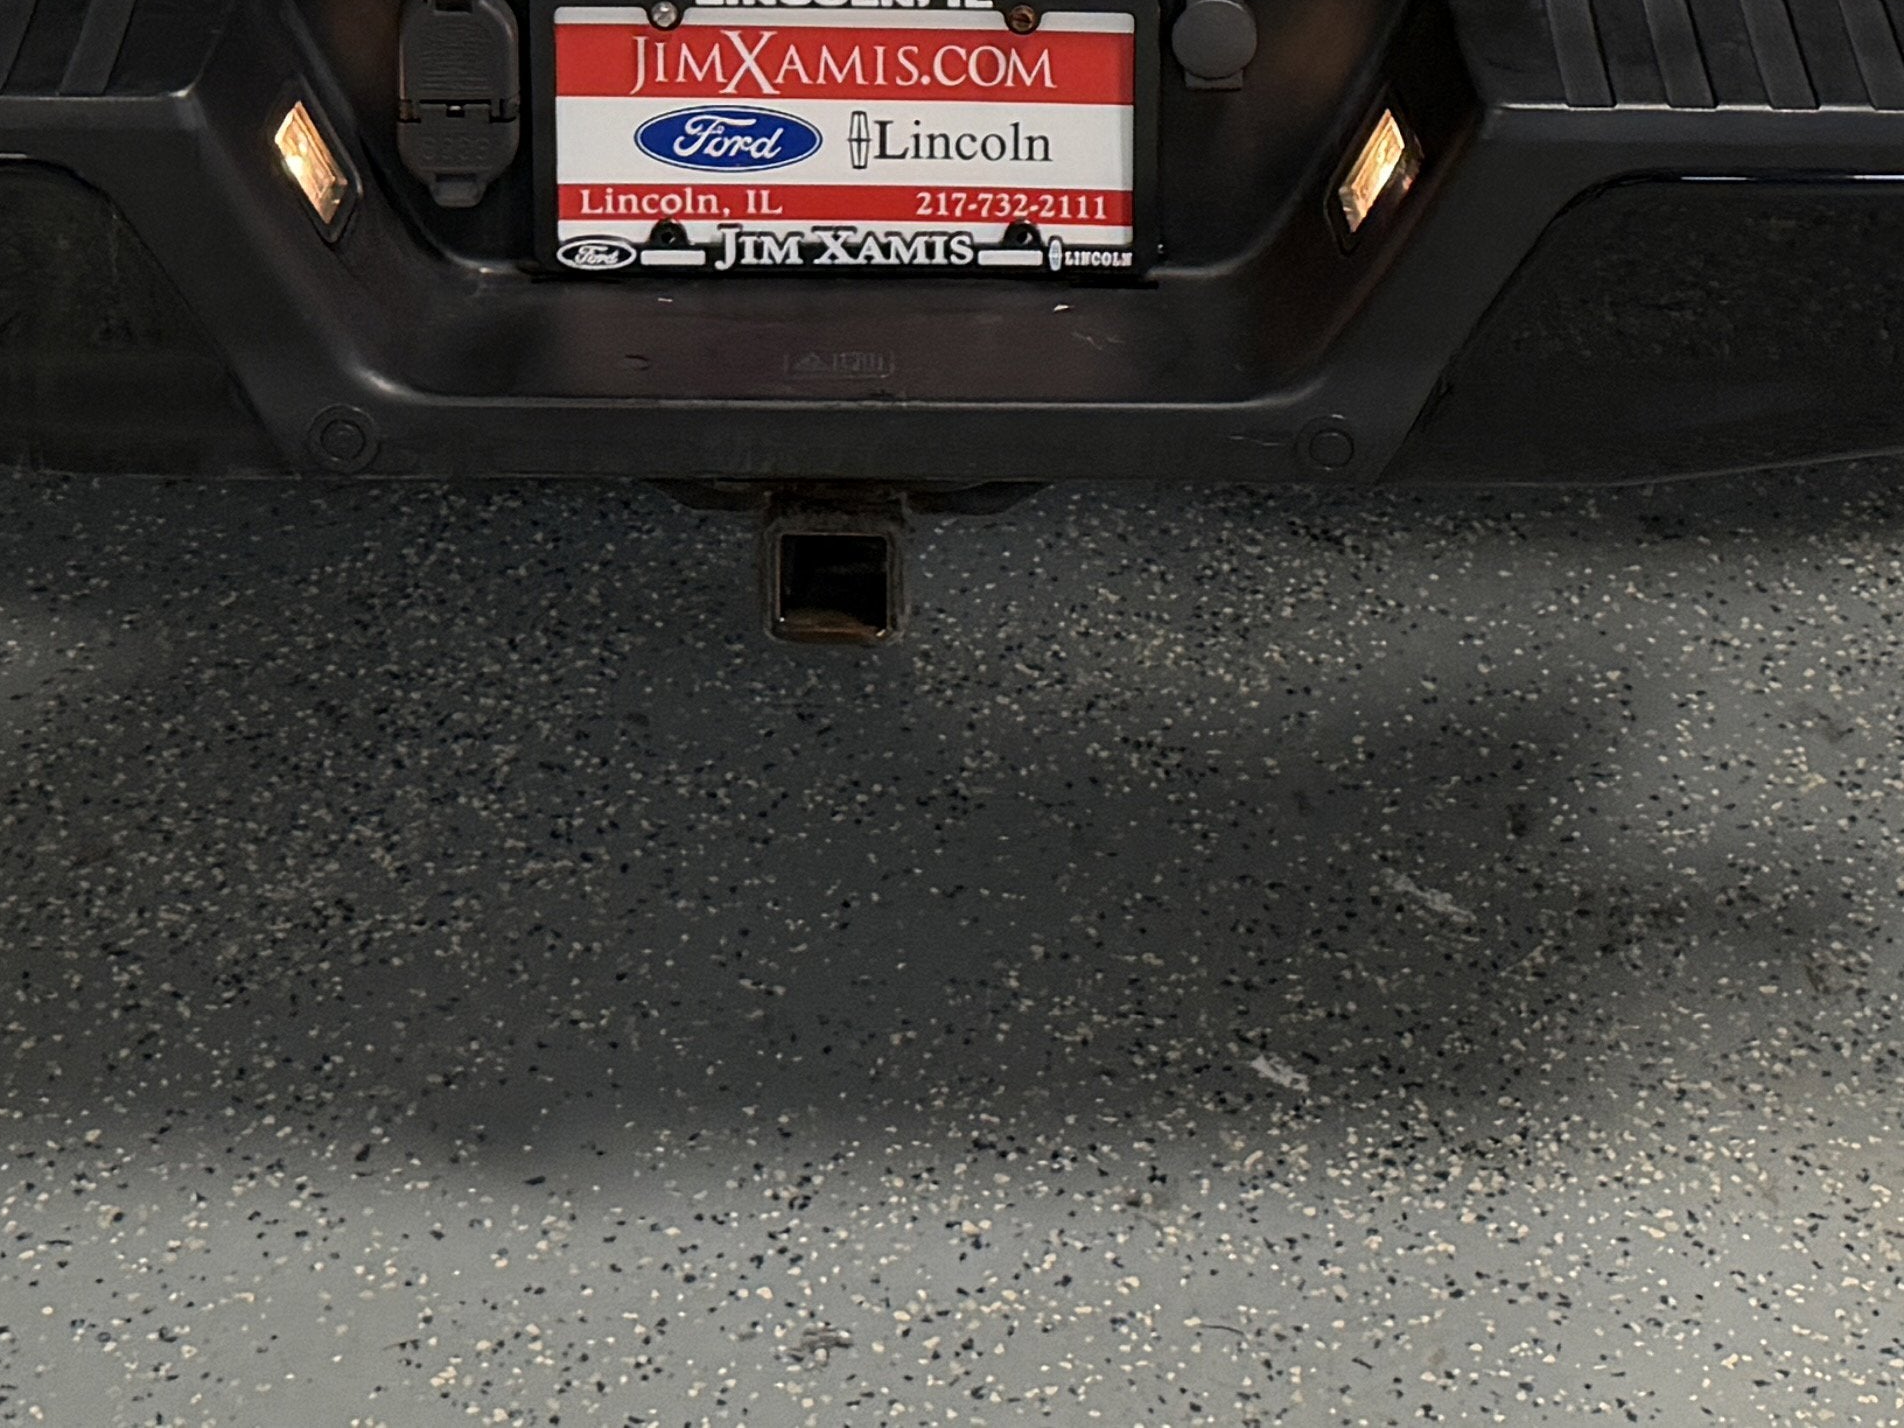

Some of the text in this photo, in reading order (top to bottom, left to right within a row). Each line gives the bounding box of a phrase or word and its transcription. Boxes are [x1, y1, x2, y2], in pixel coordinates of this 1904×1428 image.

[629, 30, 1058, 95] JIMXAMIS.COM
[673, 115, 784, 161] Ford
[874, 120, 1054, 162] Lincoln
[580, 187, 783, 218] Lincoln, IL
[916, 192, 1108, 219] 217-732-2111
[574, 246, 622, 266] Ford
[714, 227, 974, 271] JIM XAMIS
[1064, 252, 1133, 267] LINCOLN
